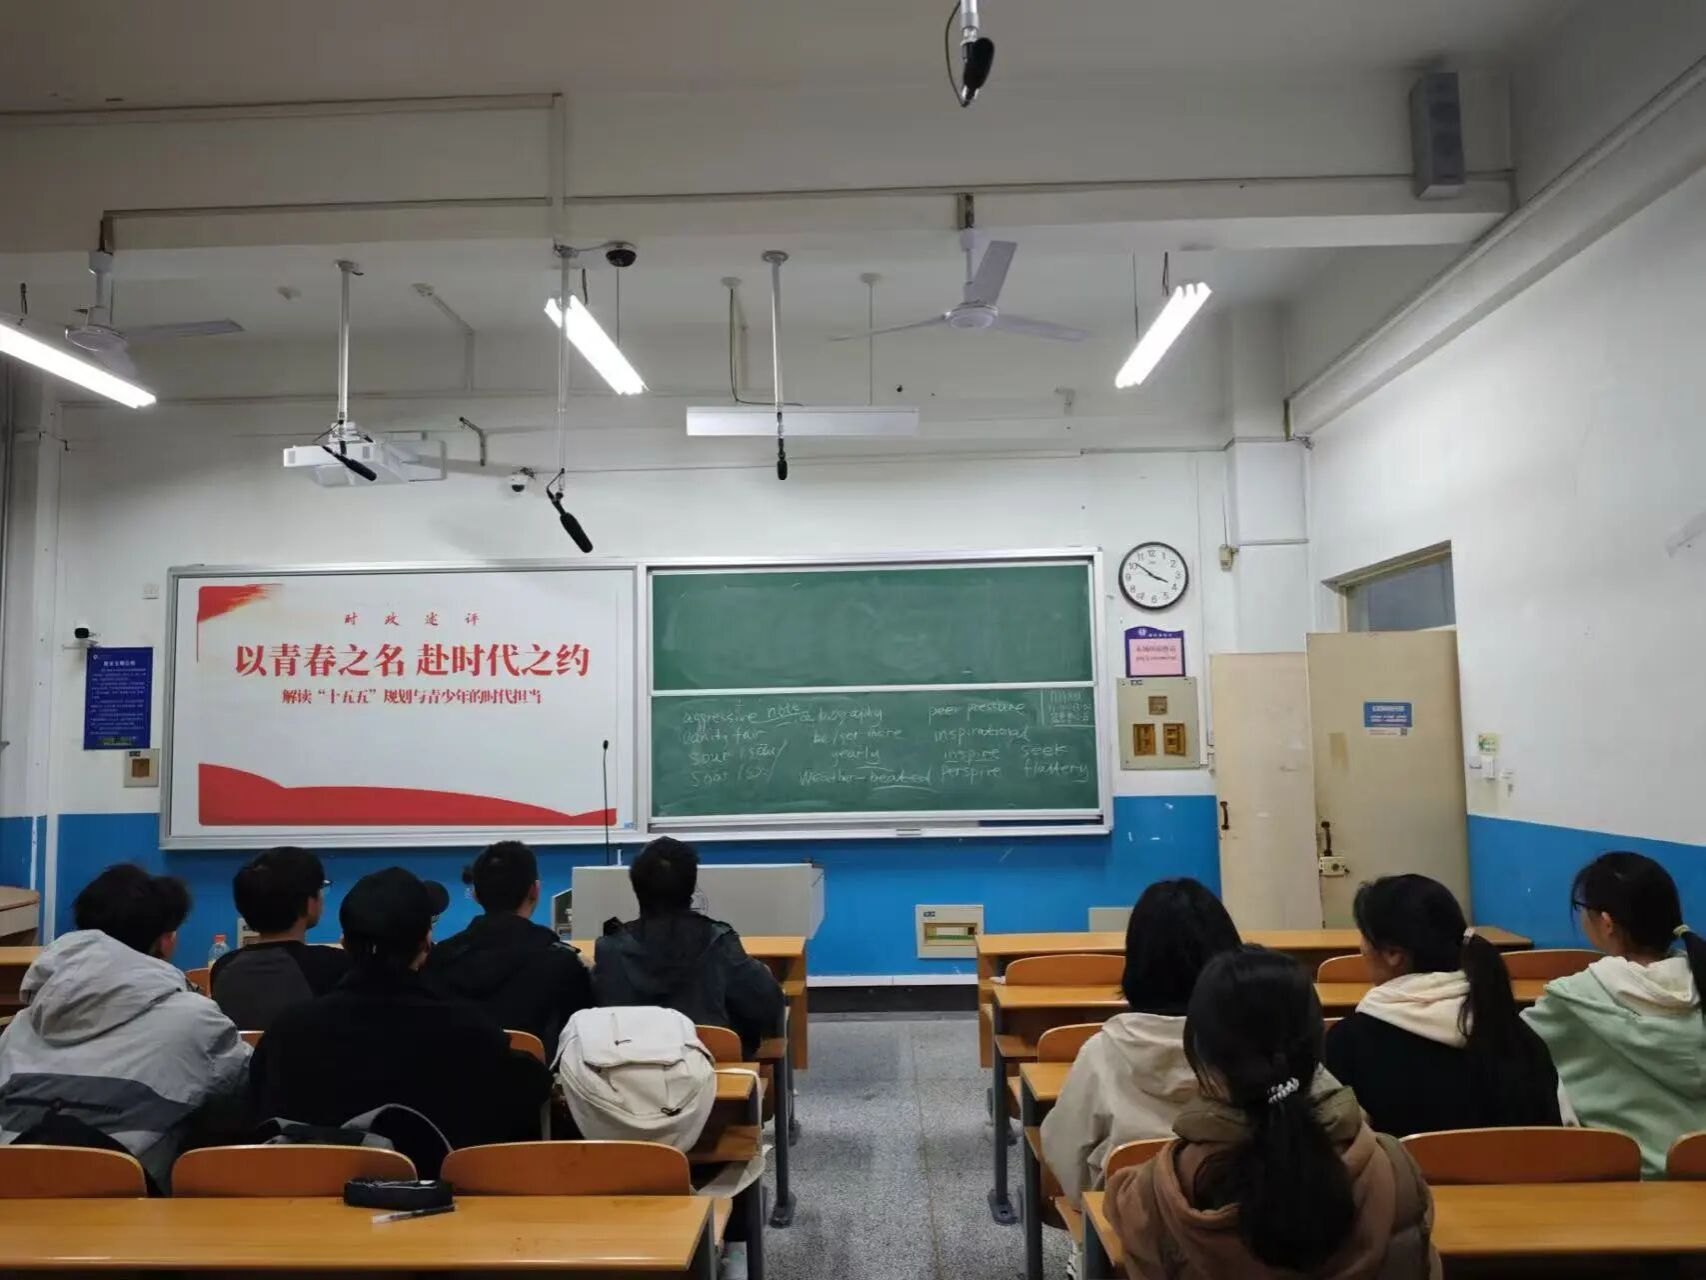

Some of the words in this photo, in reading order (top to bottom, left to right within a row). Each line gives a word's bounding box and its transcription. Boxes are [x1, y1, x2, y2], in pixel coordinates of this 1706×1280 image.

[344, 611, 481, 626] 时政述评
[235, 643, 405, 677] 以青春之名
[416, 643, 590, 677] 赴时代之约
